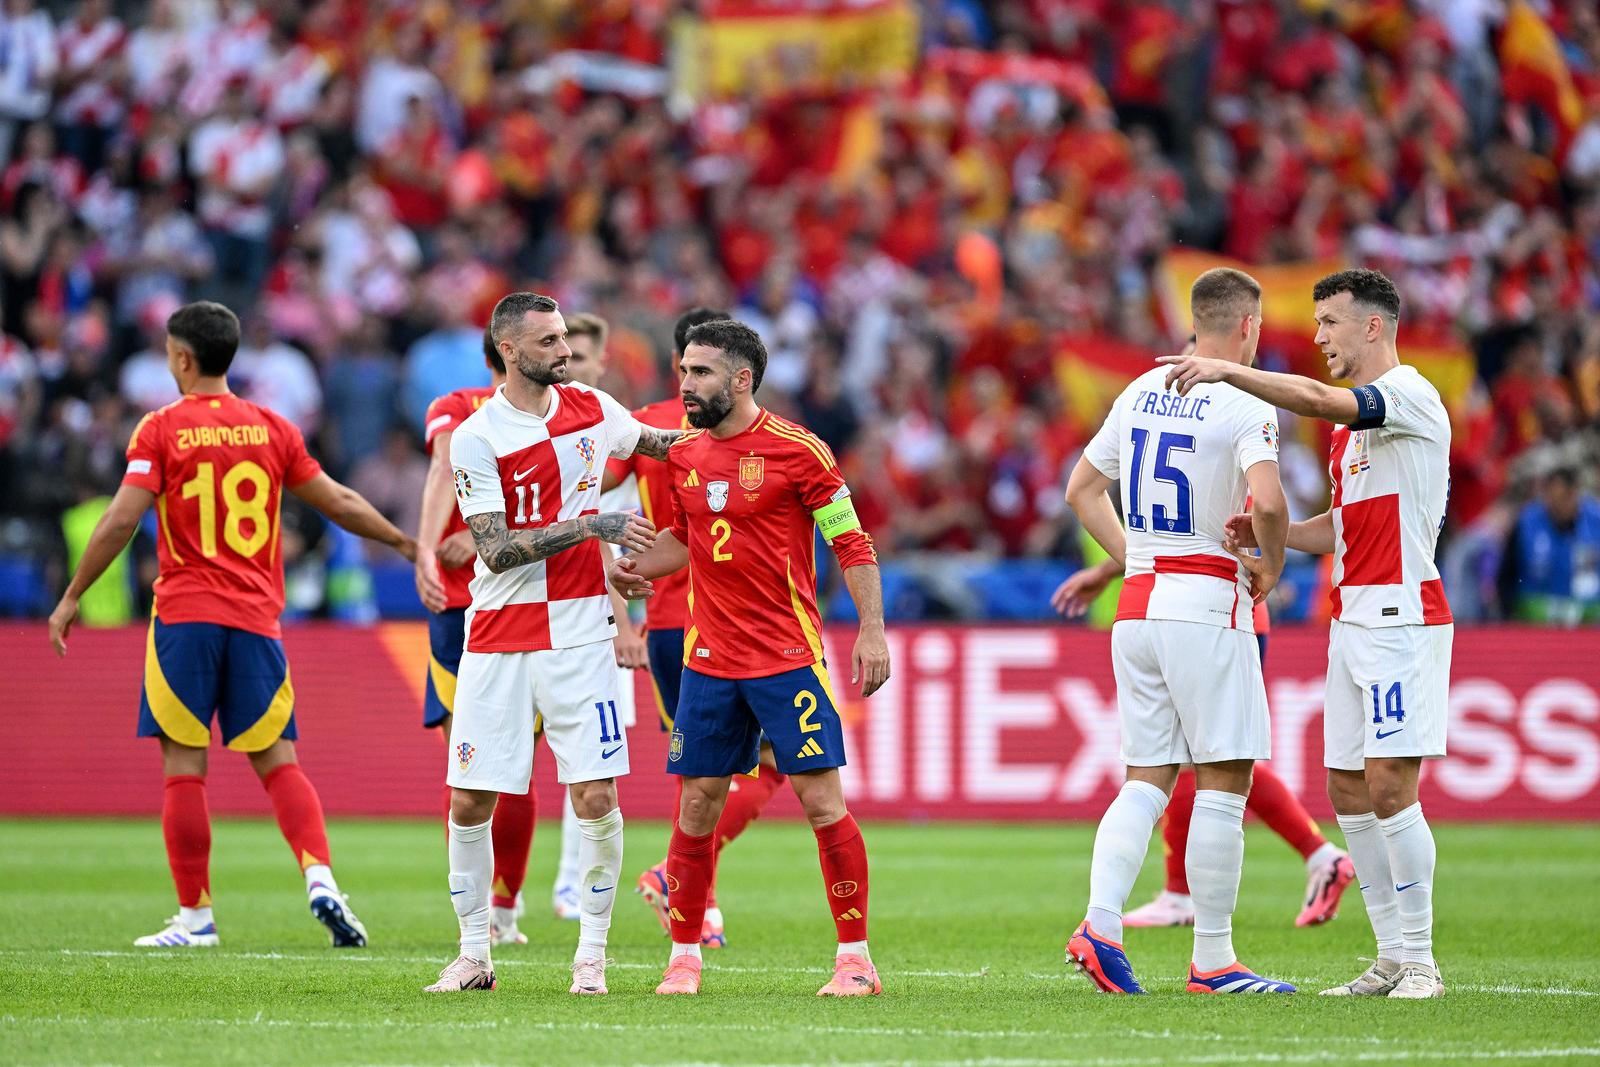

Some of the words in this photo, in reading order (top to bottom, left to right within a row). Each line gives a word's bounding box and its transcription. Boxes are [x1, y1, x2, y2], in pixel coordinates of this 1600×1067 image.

[175, 425, 270, 450] ZUBIMENDI
[514, 482, 543, 524] 11
[1128, 427, 1196, 537] 15
[182, 460, 271, 559] 18
[828, 510, 854, 526] RESPECT
[710, 518, 733, 562] 2
[594, 700, 622, 743] 11
[793, 689, 822, 734] 2
[1370, 681, 1406, 725] 14
